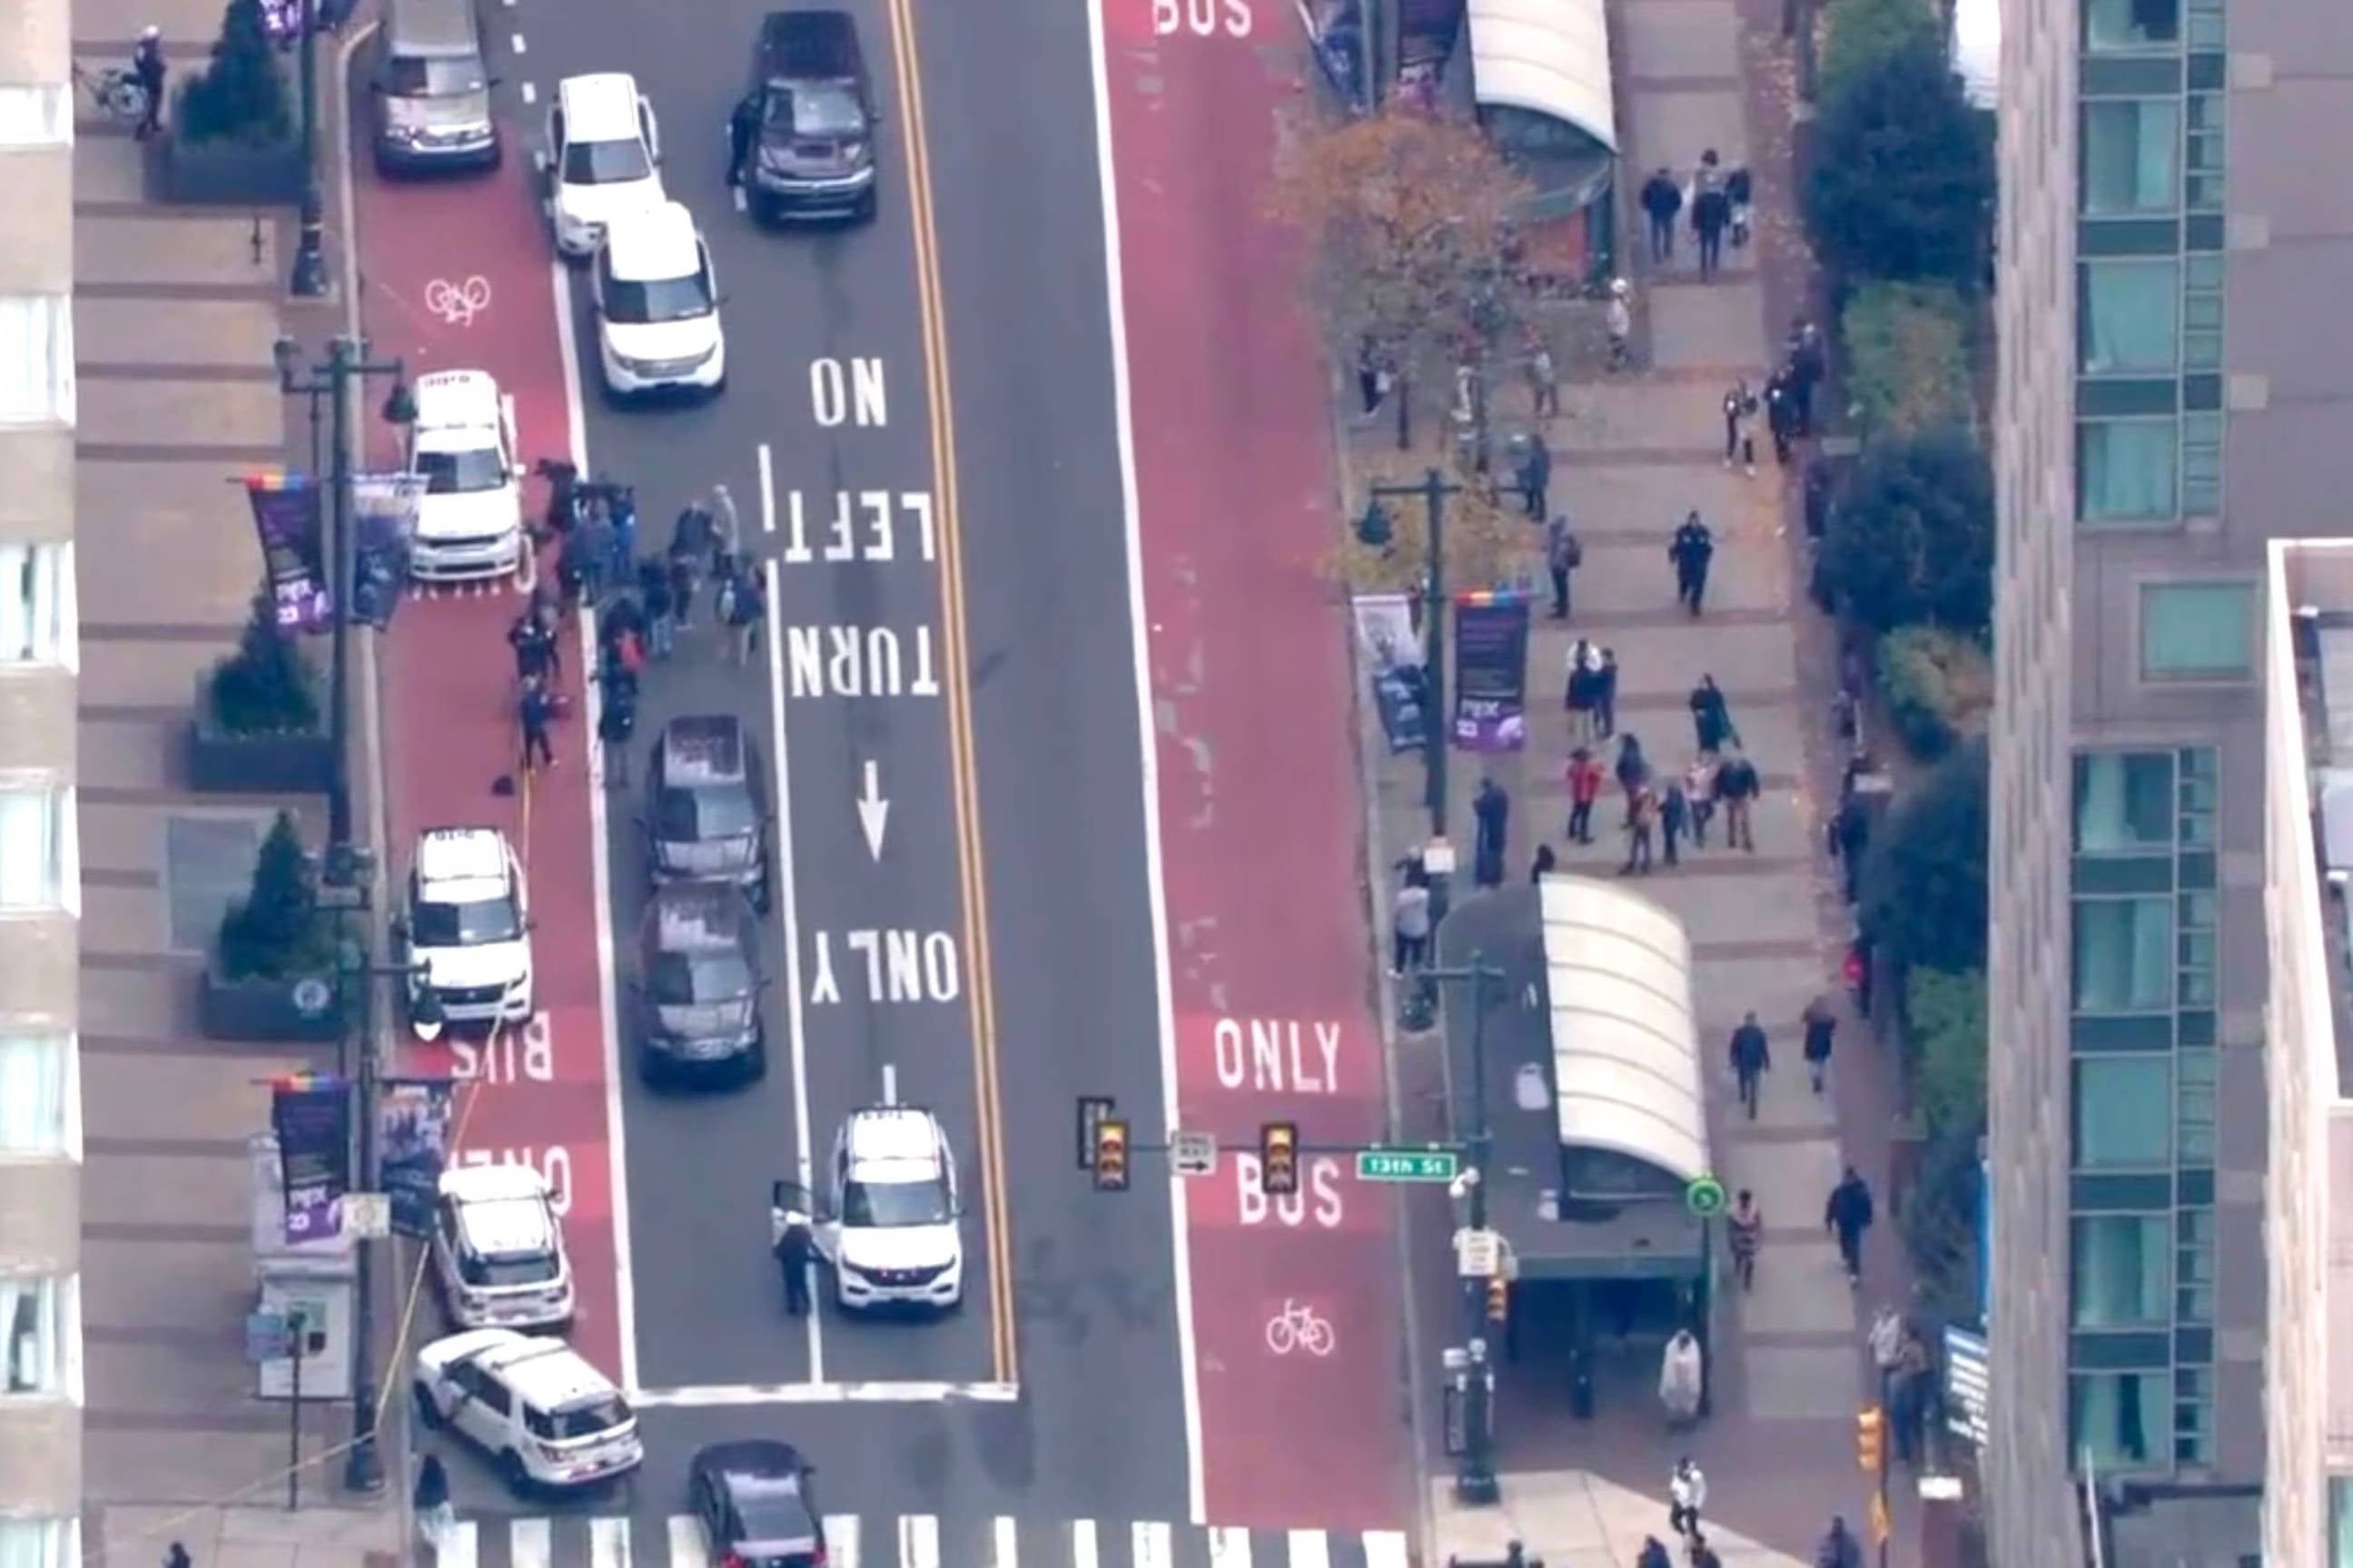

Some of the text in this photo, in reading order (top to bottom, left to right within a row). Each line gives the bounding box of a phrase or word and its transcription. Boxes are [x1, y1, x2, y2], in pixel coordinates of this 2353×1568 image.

[810, 358, 887, 427] NO
[785, 490, 934, 562] LEFT
[788, 626, 939, 697] TURN
[811, 930, 959, 1003] ONLY
[1214, 1018, 1340, 1092] ONLY
[1369, 1158, 1445, 1174] 13th St
